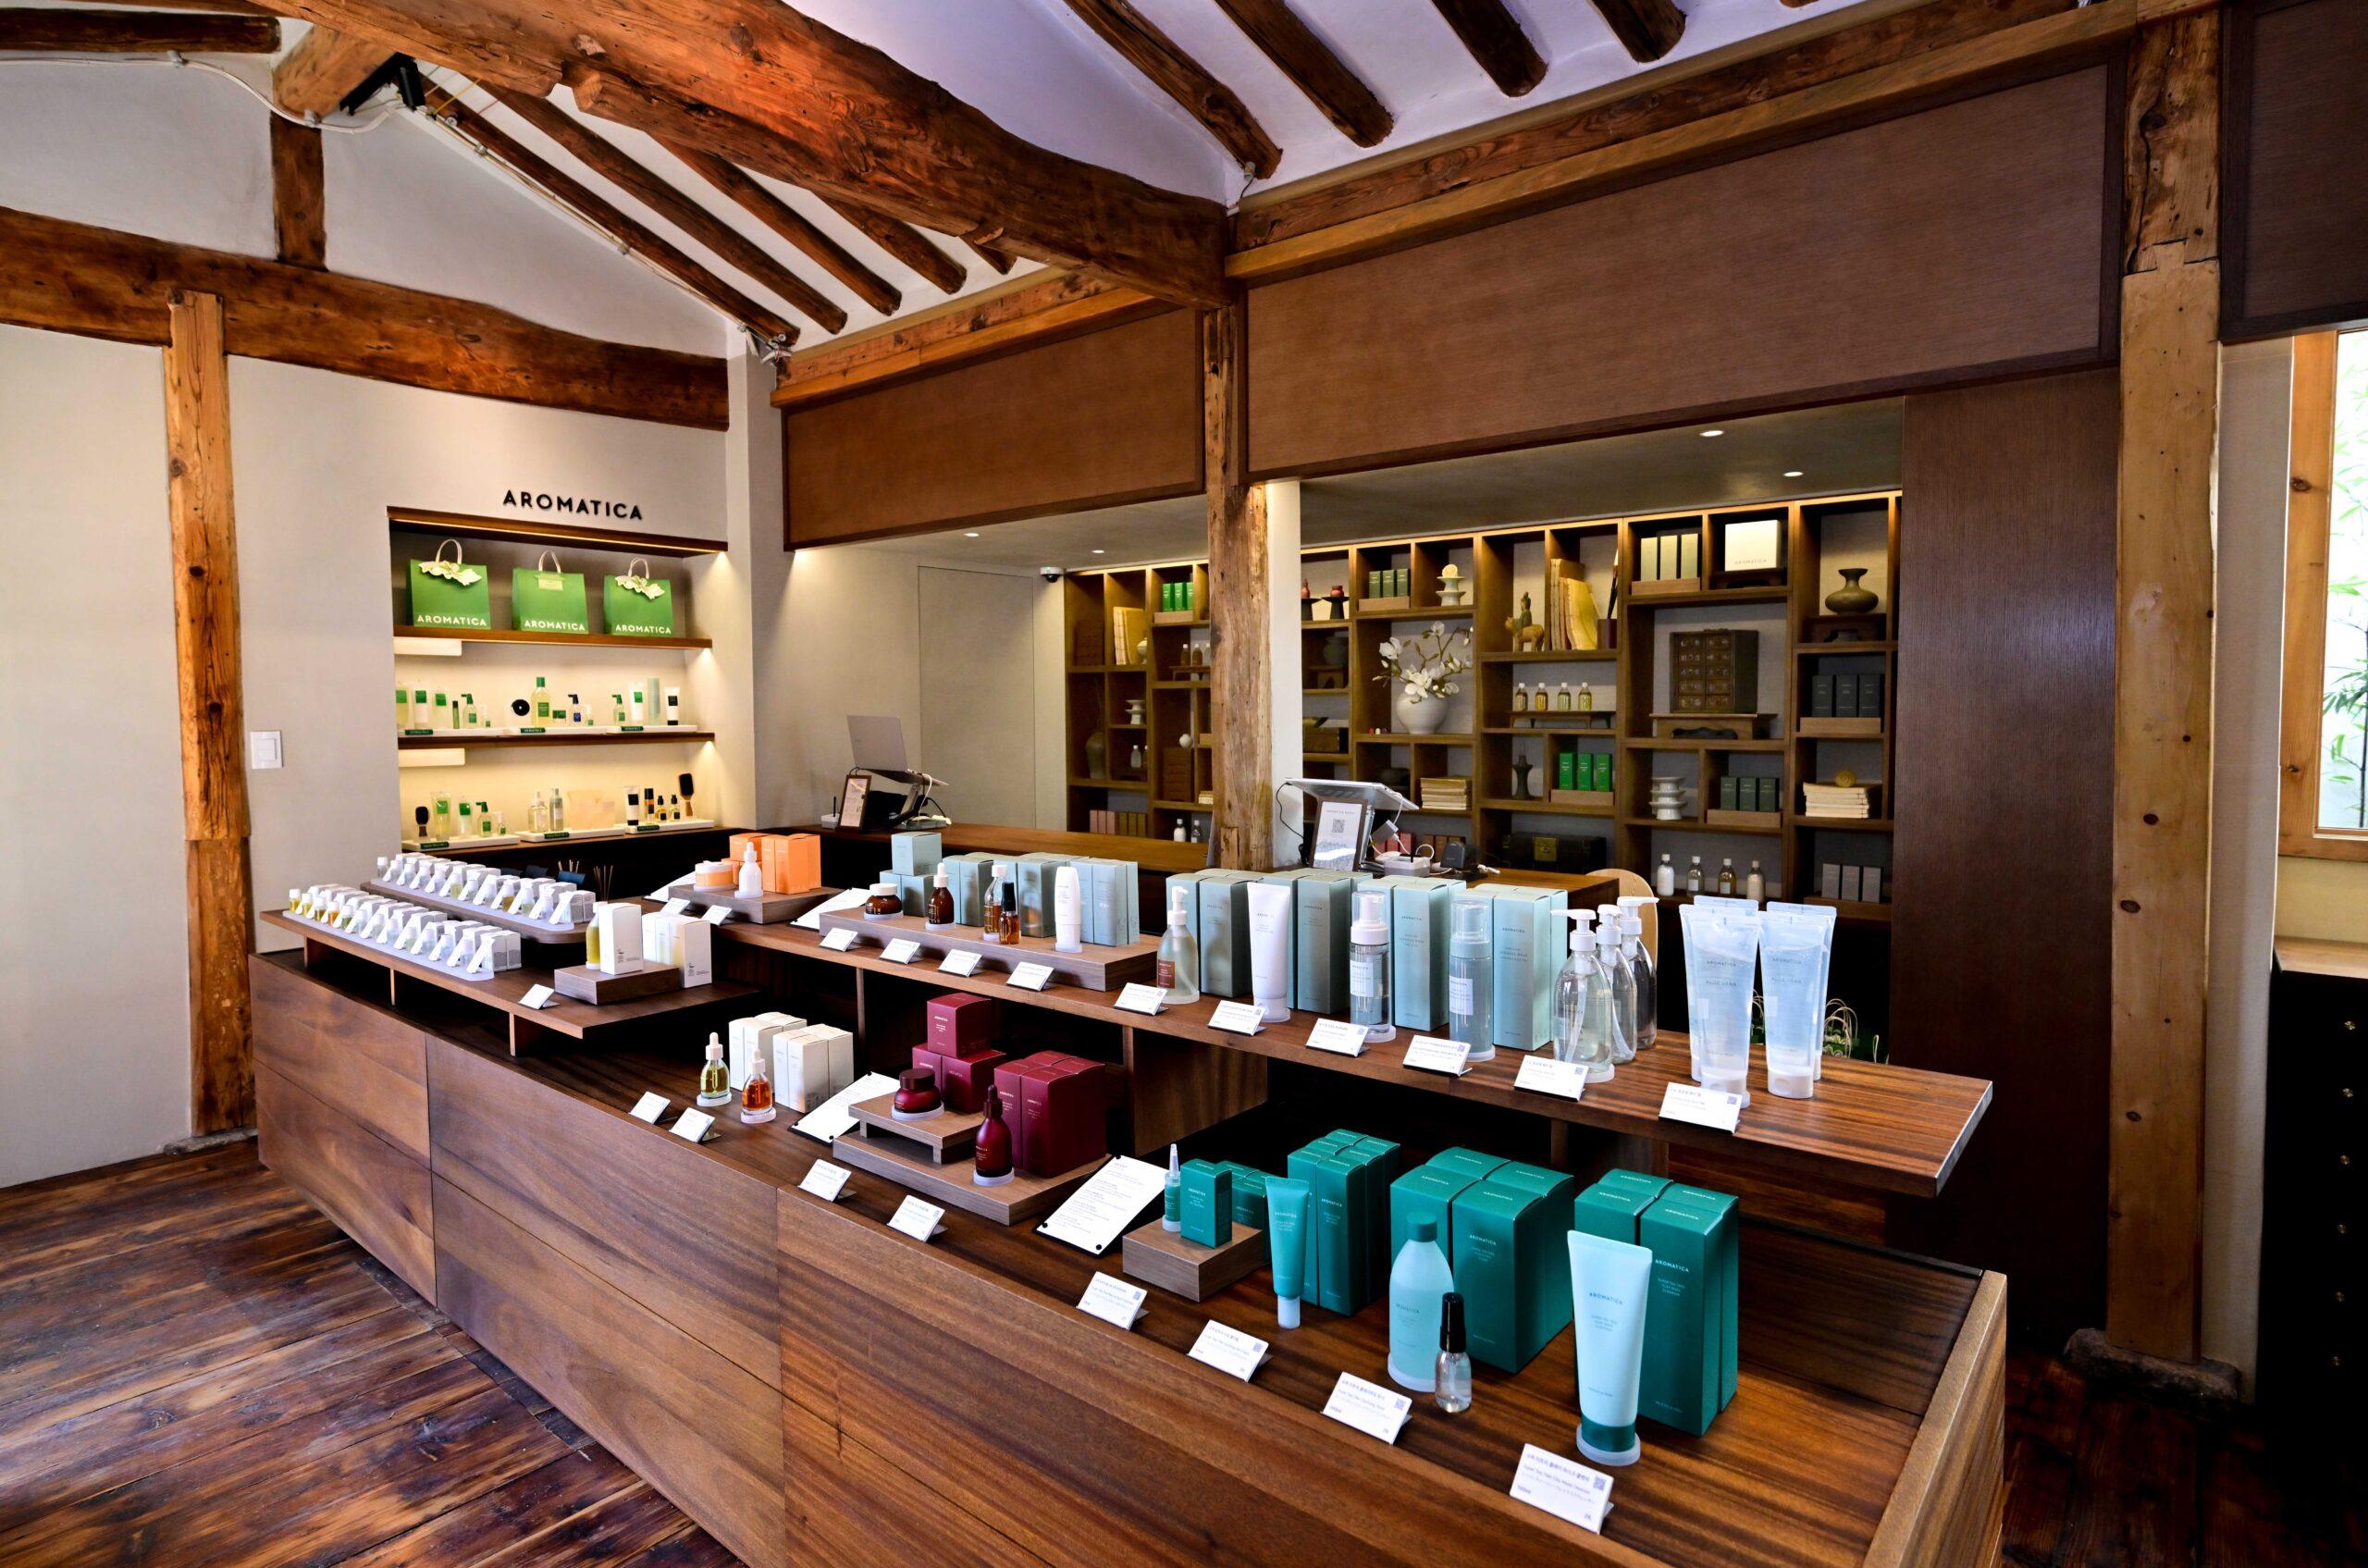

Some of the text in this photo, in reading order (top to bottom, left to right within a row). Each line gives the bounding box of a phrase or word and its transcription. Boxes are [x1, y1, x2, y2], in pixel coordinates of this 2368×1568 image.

[502, 488, 644, 521] AROMATICA
[416, 614, 487, 627] AROMATICA
[524, 619, 586, 632] AROMATICA
[615, 623, 672, 636] AROMATICA
[1469, 1233, 1497, 1246] AROMATICA
[1655, 1258, 1690, 1273] AROMATICA
[1589, 1291, 1623, 1304] AROMATICA
